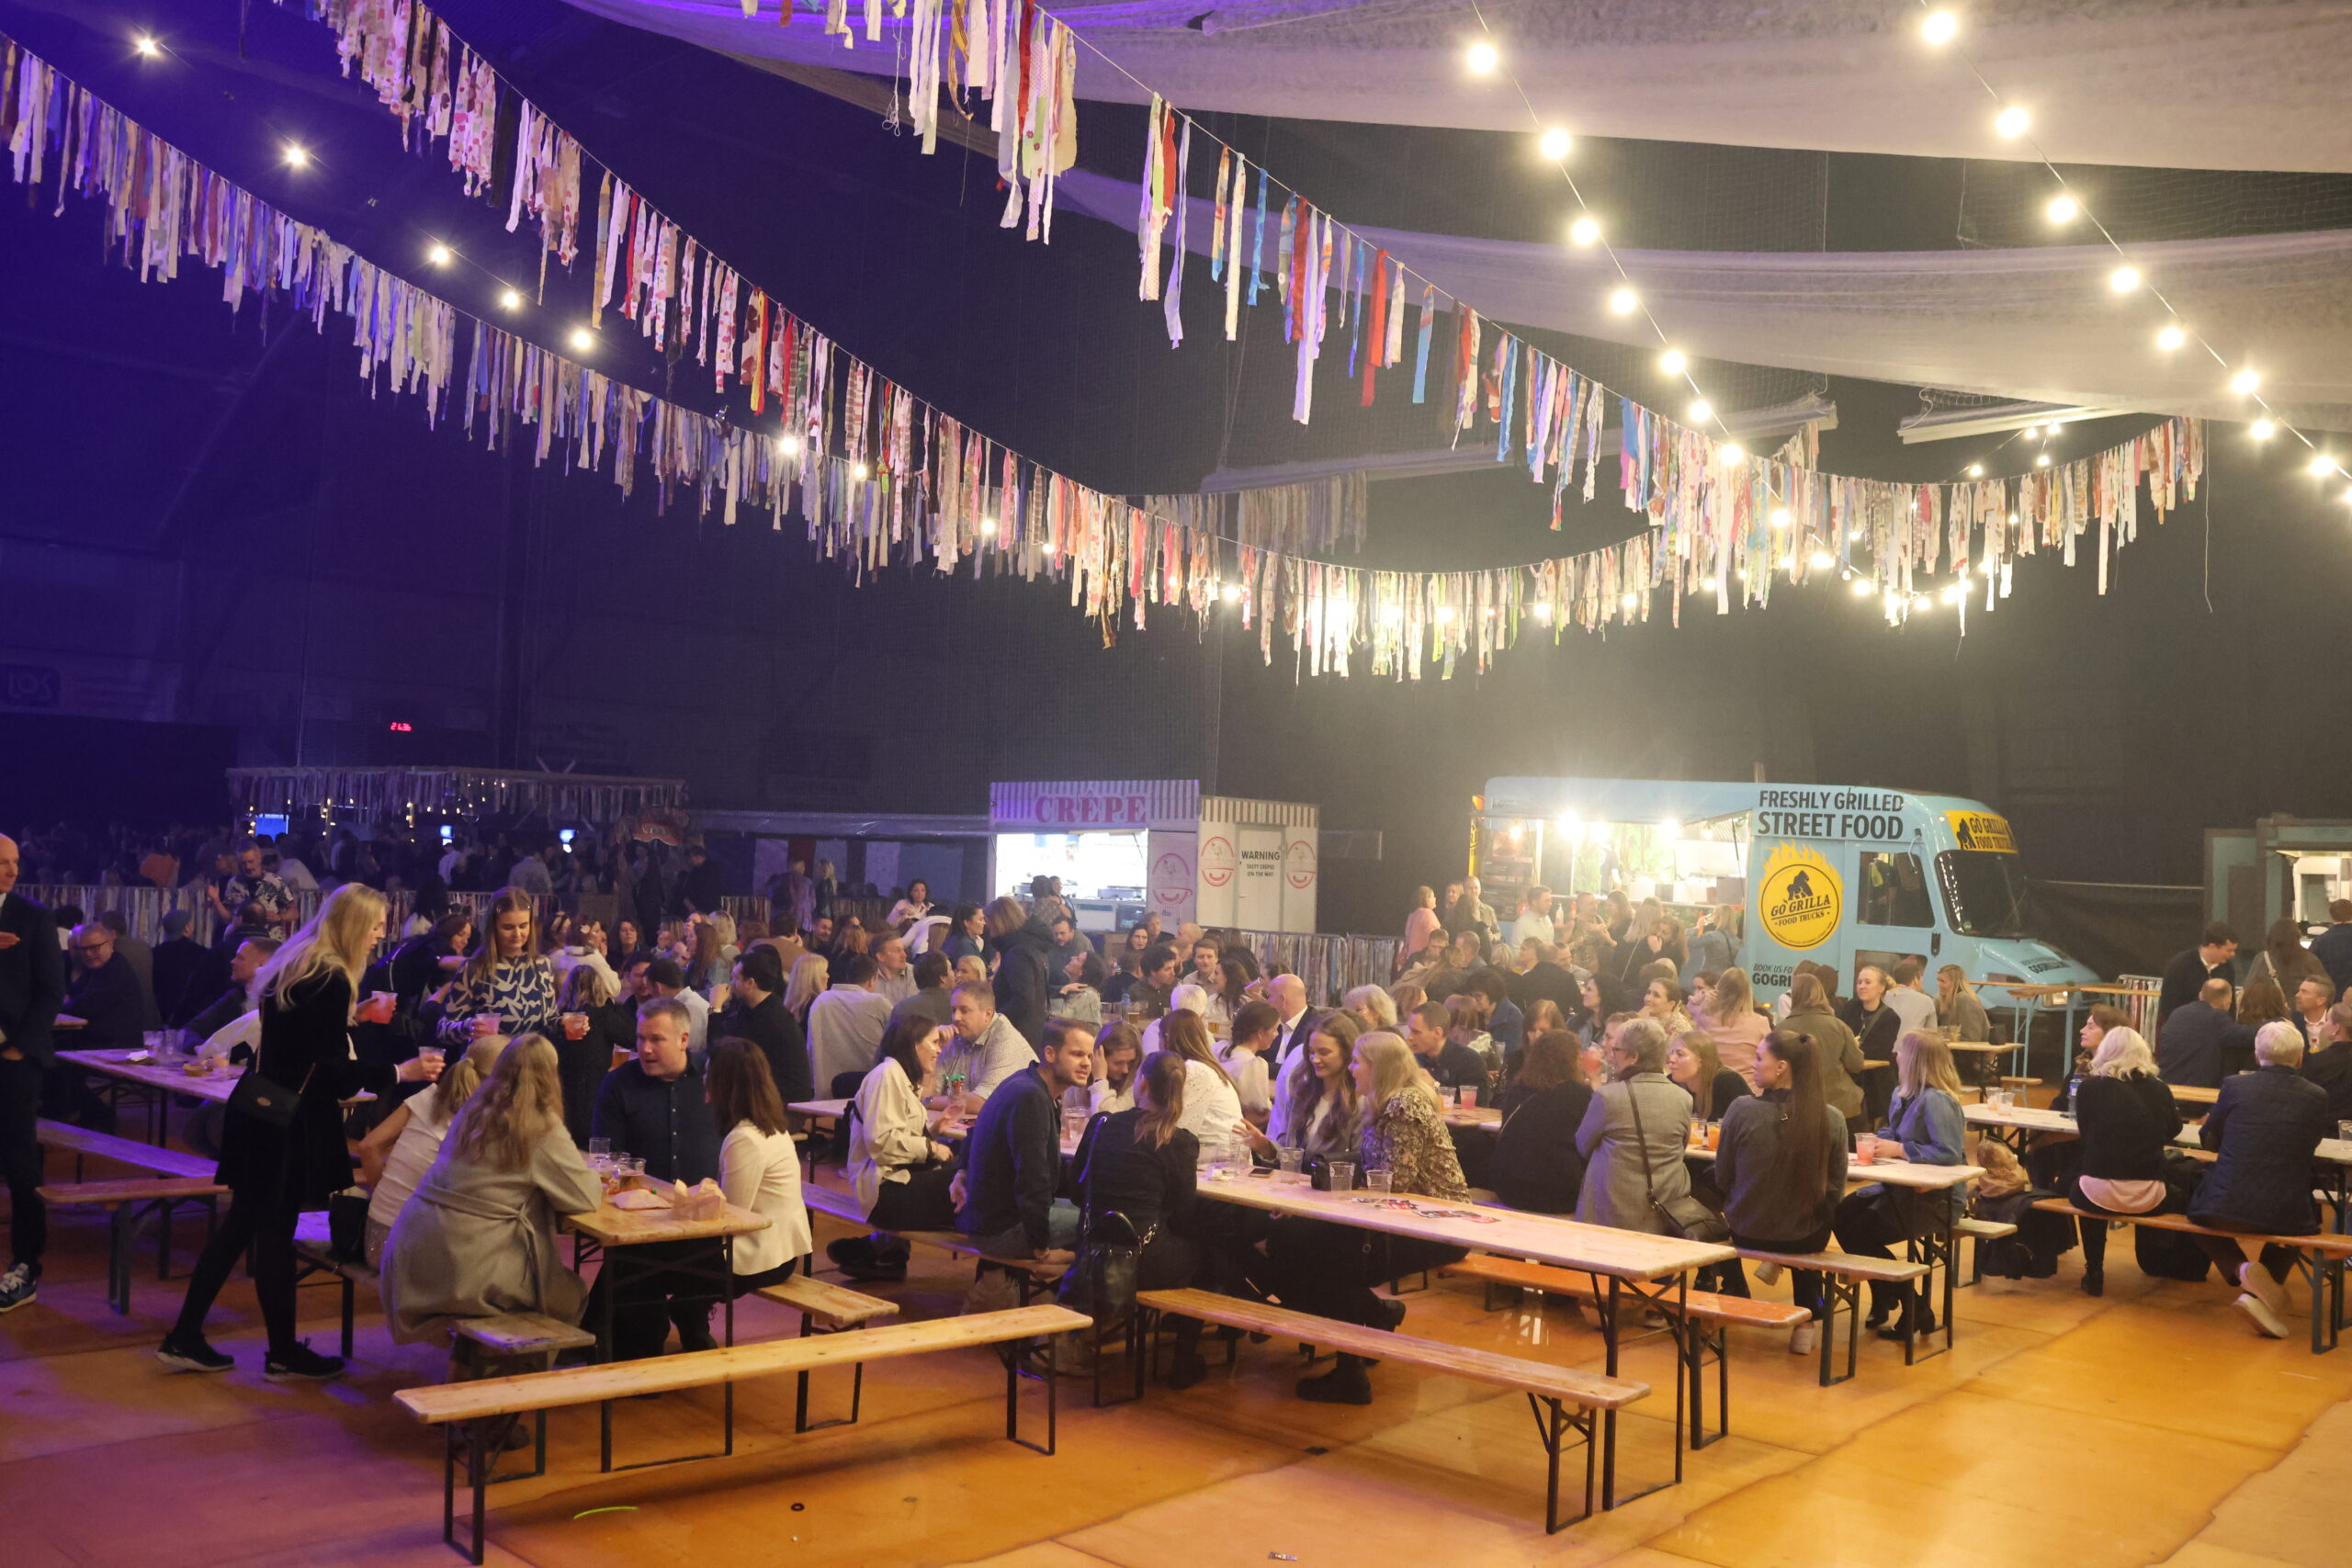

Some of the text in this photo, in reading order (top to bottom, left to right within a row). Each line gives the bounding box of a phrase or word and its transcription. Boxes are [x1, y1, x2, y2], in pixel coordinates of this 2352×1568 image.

[1759, 790, 1905, 811] FRESHLY GRILLED
[1758, 811, 1904, 840] STREET FOOD
[1241, 851, 1280, 860] WARNING
[1789, 894, 1831, 913] GRILLA
[1778, 909, 1825, 927] FOOD TRUCKS
[1753, 963, 1794, 975] BOOK US FO
[1752, 972, 1792, 987] GOGRI
